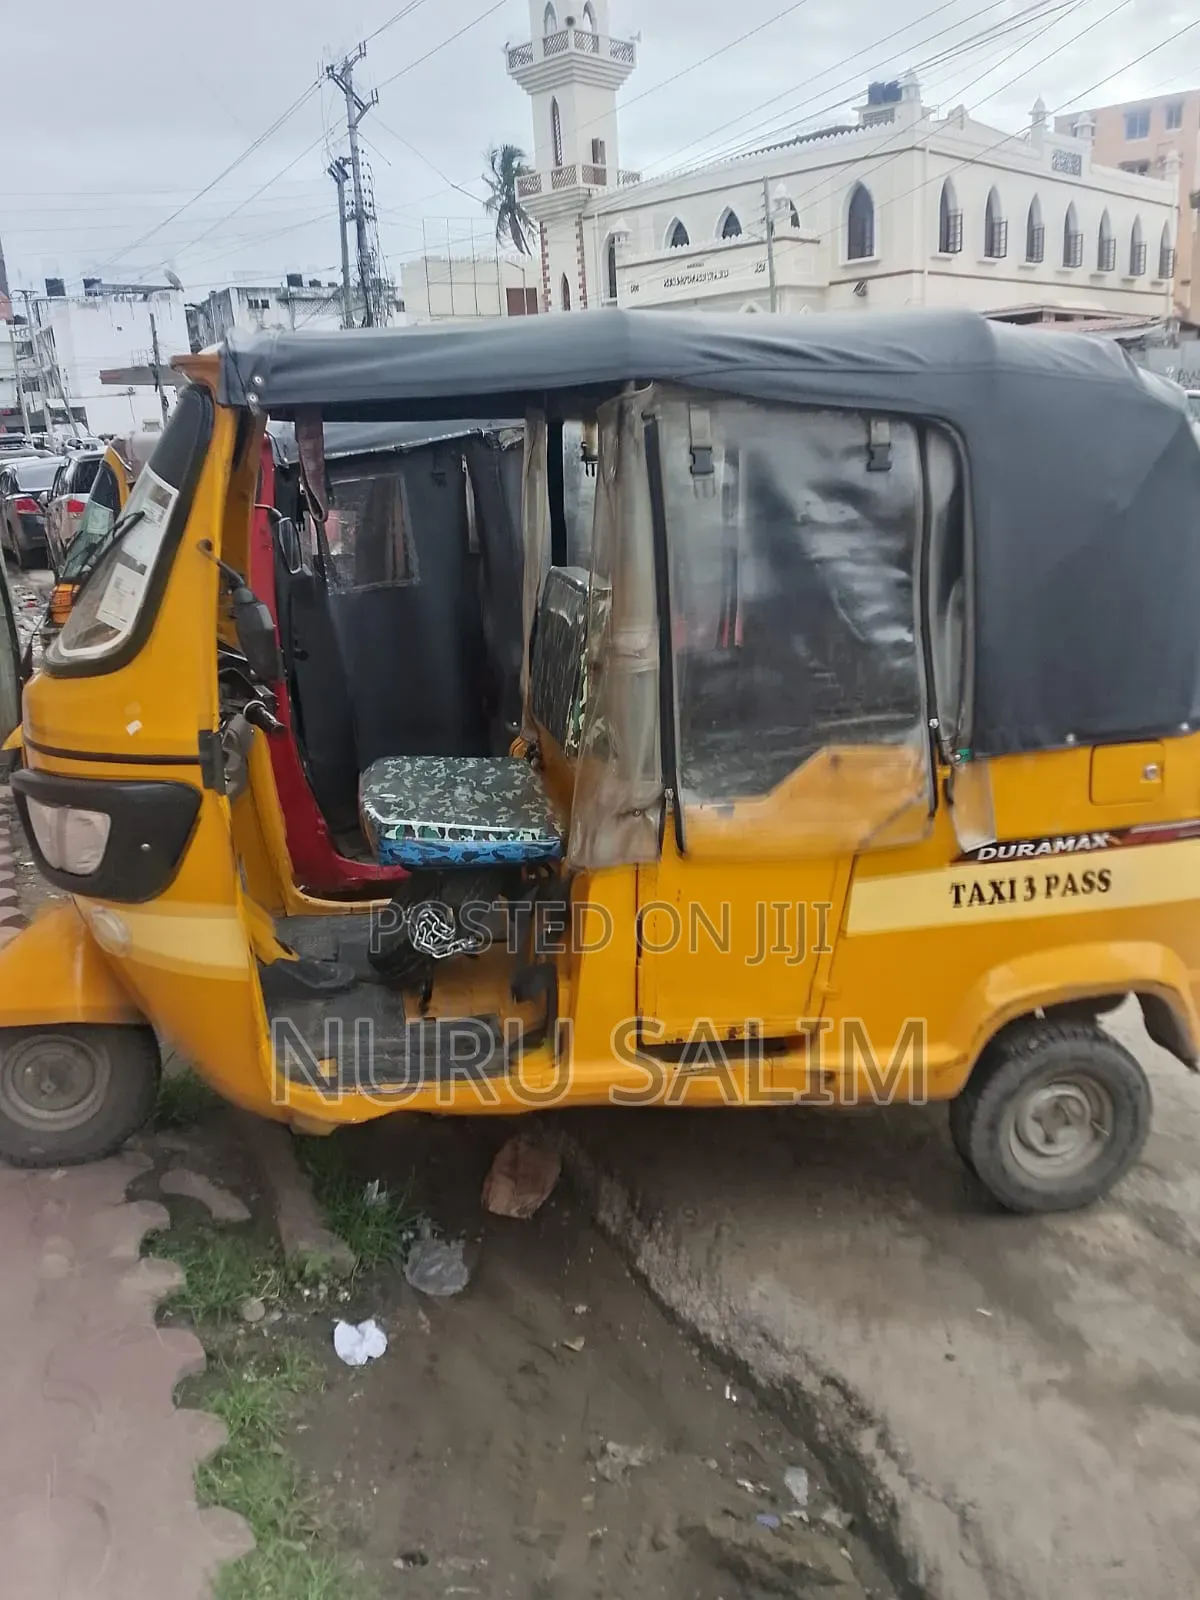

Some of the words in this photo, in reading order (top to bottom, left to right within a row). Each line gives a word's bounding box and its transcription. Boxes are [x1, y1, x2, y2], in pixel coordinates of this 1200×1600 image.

[976, 832, 1110, 861] DURAMAX
[951, 876, 1017, 908] TAXI
[1023, 874, 1037, 902] 3
[1045, 867, 1112, 900] PASS
